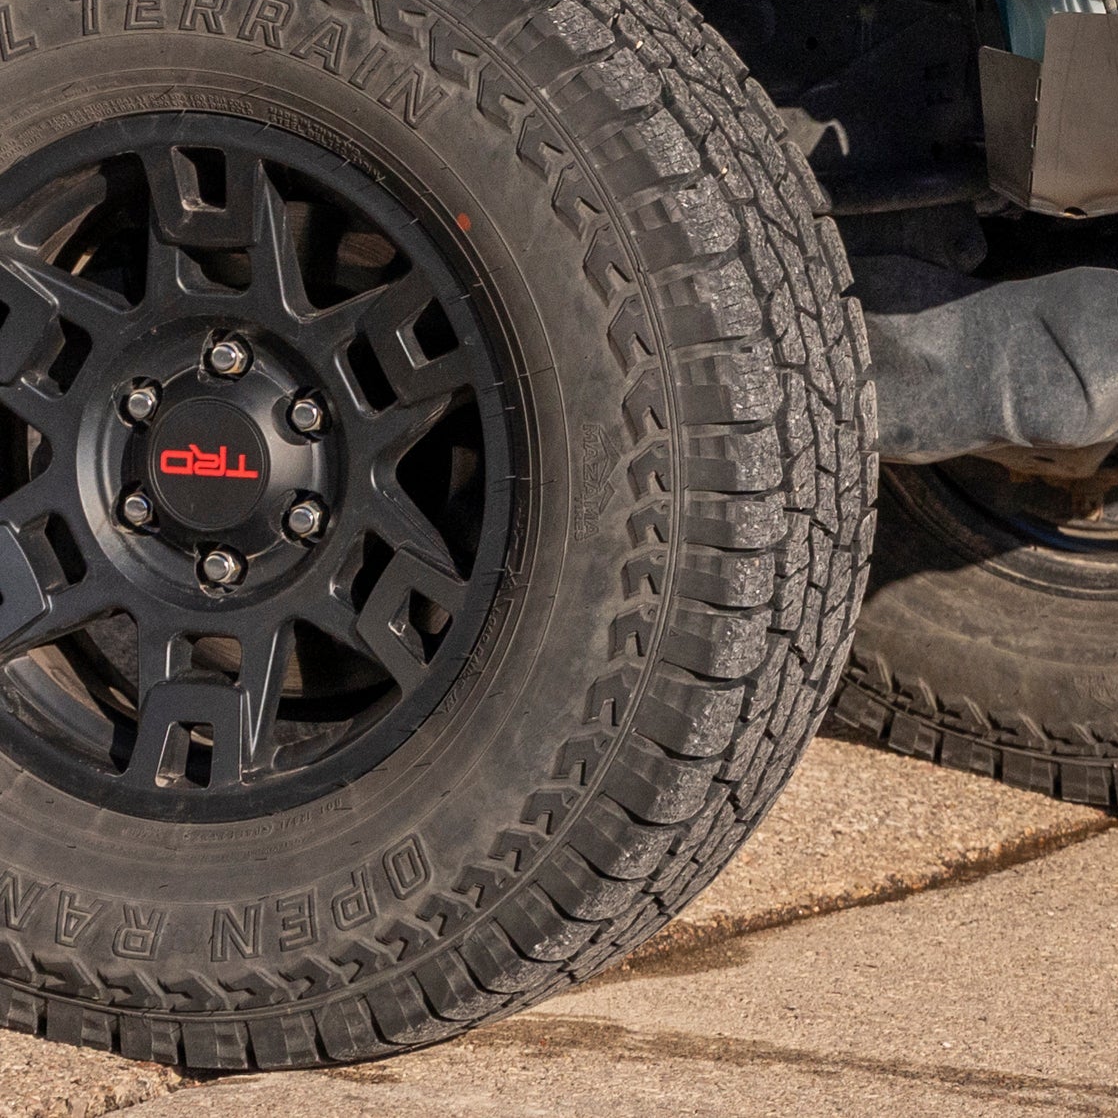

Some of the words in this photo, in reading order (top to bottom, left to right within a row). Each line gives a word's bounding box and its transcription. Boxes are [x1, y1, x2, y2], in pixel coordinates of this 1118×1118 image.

[160, 443, 258, 479] TRD
[582, 424, 600, 540] MAZAMA
[210, 832, 431, 963] OPEN
